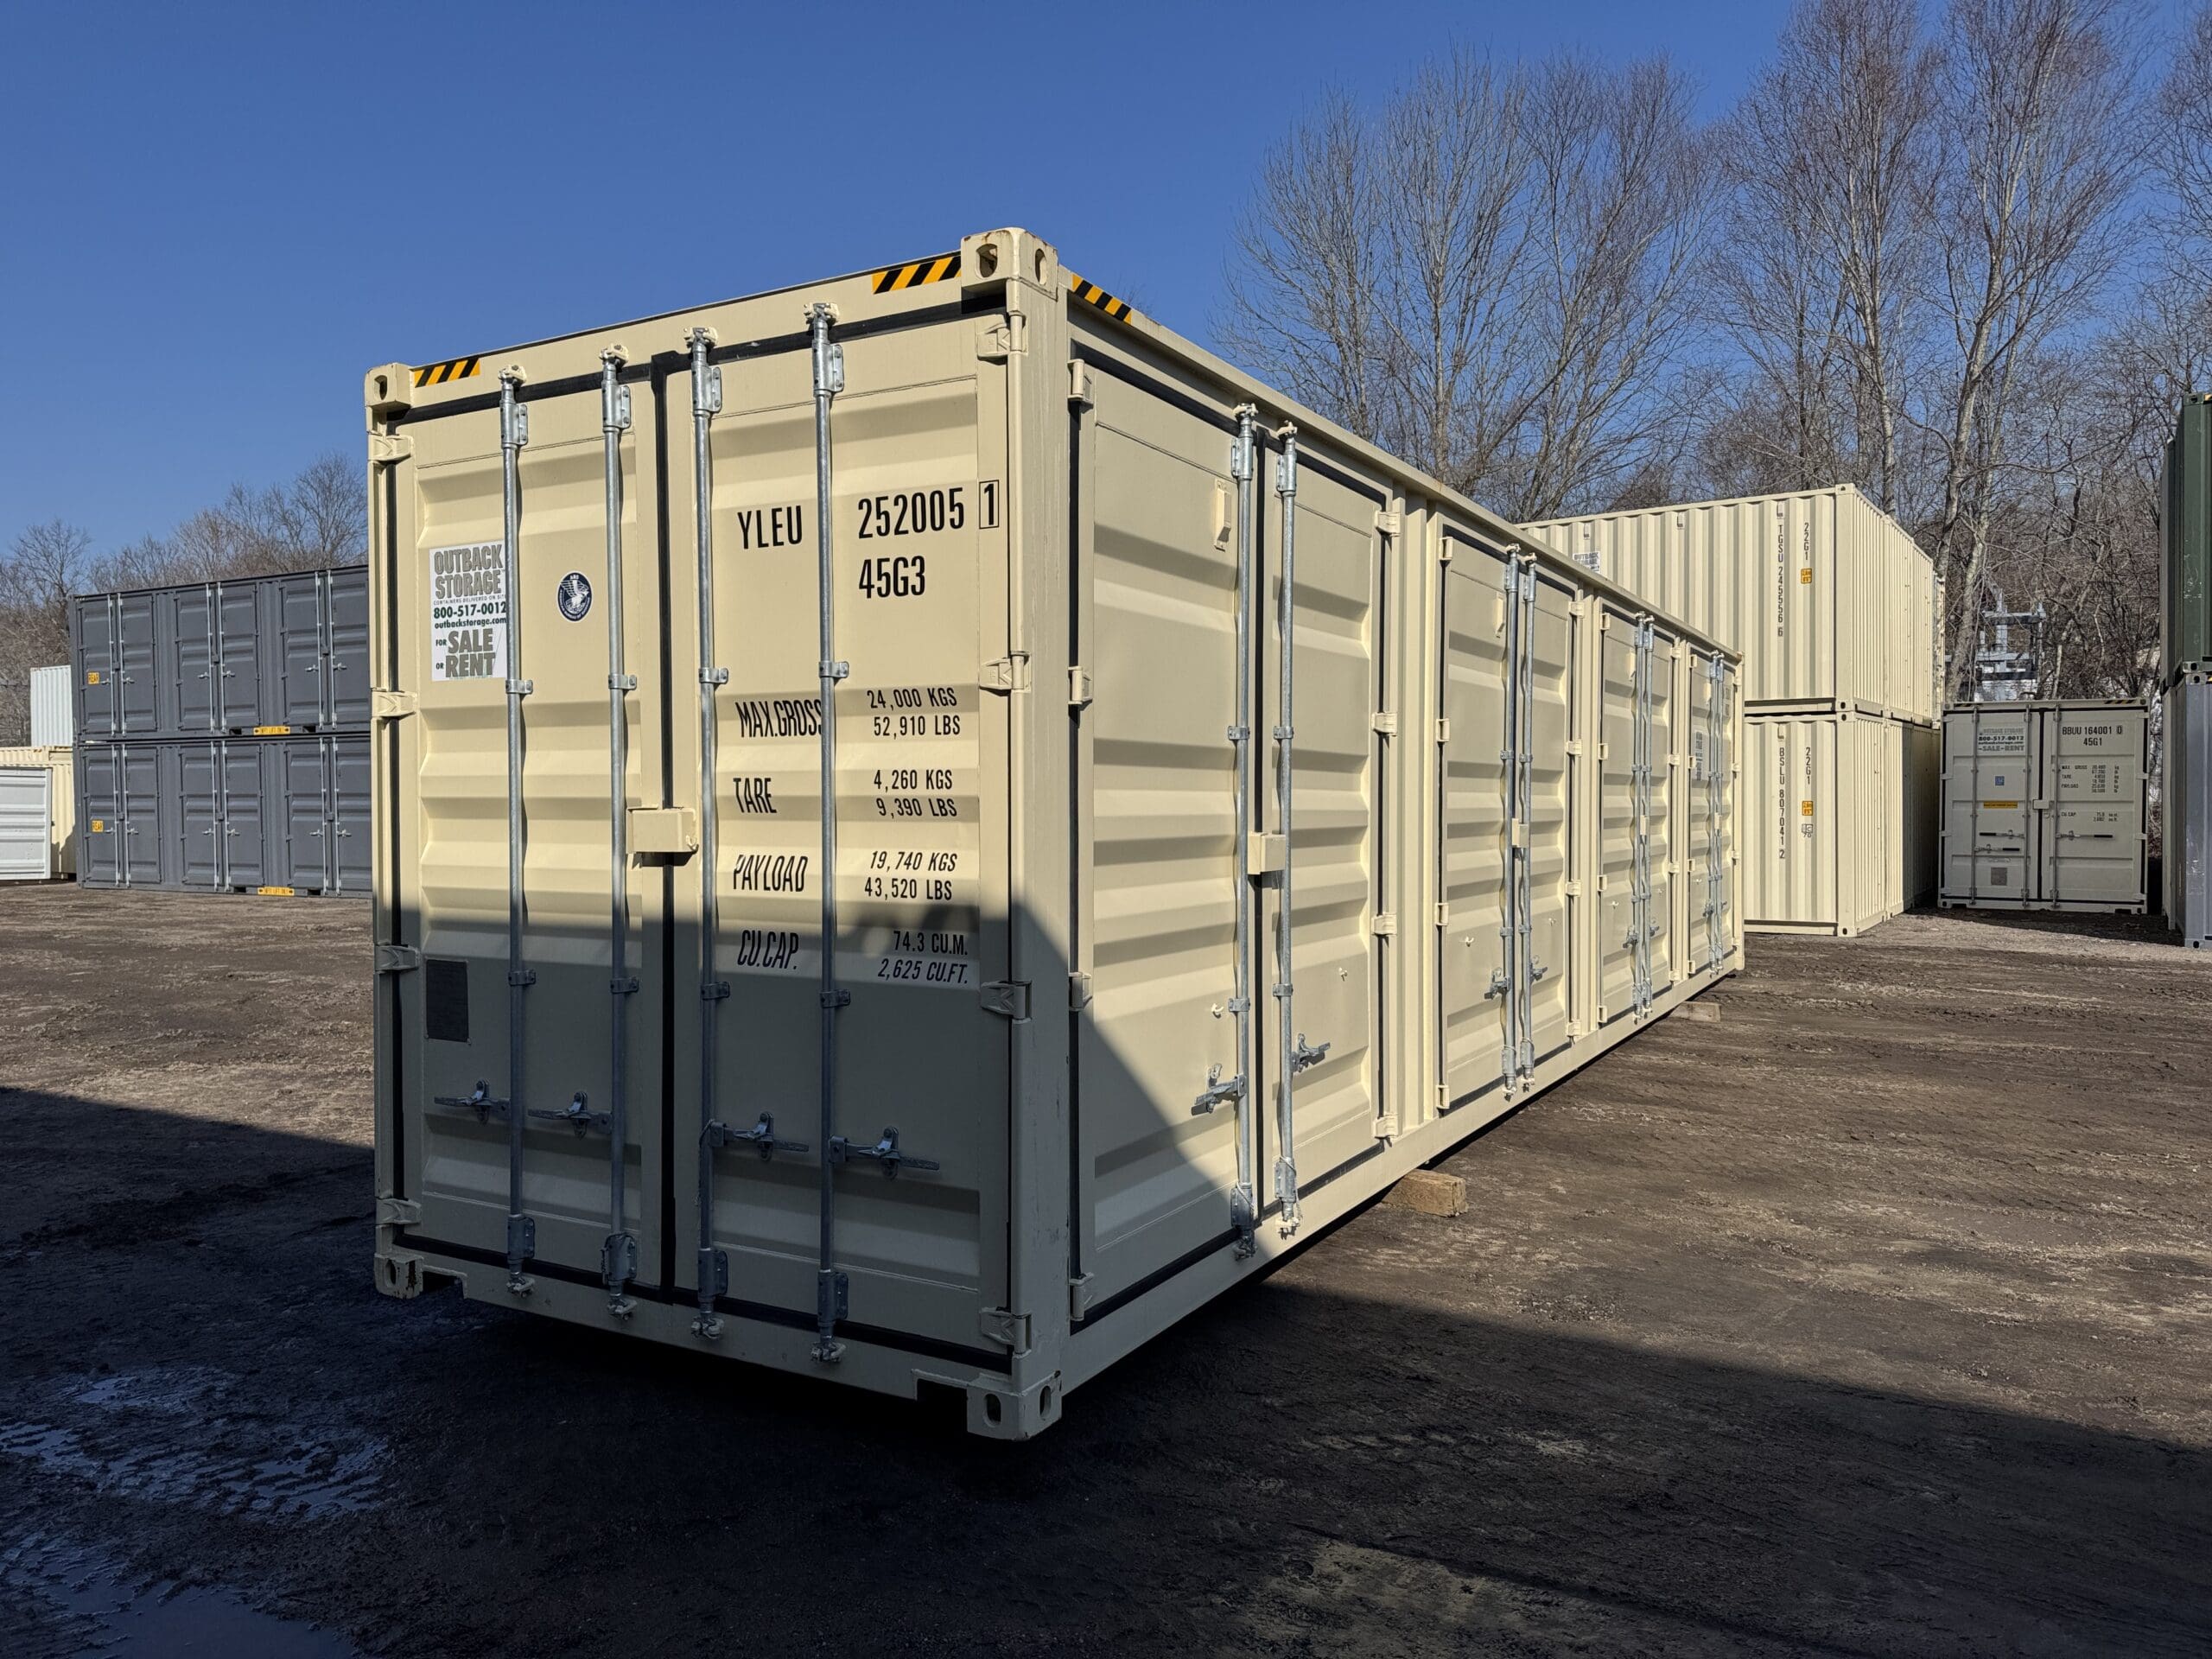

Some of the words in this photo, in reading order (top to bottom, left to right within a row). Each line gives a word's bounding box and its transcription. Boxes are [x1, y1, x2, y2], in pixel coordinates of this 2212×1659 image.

[737, 505, 802, 549] YLEU
[858, 487, 964, 539] 252005
[983, 483, 994, 525] 1
[434, 543, 503, 575] OUTBACK
[435, 569, 501, 599] STORAGE
[858, 556, 925, 599] 45G3
[434, 601, 506, 619] 800-517-0012
[435, 618, 506, 629] outbackstorage.com
[1777, 626, 1783, 637] 6
[448, 628, 493, 654] SALE
[445, 652, 496, 677] RENT
[867, 689, 922, 711] 24,000
[927, 688, 957, 707] KGS
[874, 715, 925, 739] 52,910
[935, 715, 960, 734] LBS
[2084, 726, 2112, 734] 164001
[2083, 737, 2102, 746] 45G1
[733, 778, 777, 813] TARE
[874, 769, 918, 792] 4,260
[925, 769, 952, 789] KGS
[876, 798, 922, 819] 9,390
[928, 798, 957, 817] LBS
[1779, 849, 1785, 859] 2
[733, 854, 808, 892] PAYLOAD
[870, 851, 923, 872] 19,740
[928, 852, 957, 872] KGS
[864, 877, 917, 900] 43,520
[926, 879, 952, 900] LBS
[737, 930, 799, 969] CU.CAP.
[893, 931, 925, 952] 74.3
[931, 932, 968, 956] CU.M.
[878, 958, 923, 981] 2,625
[926, 962, 968, 984] CU.FT.
